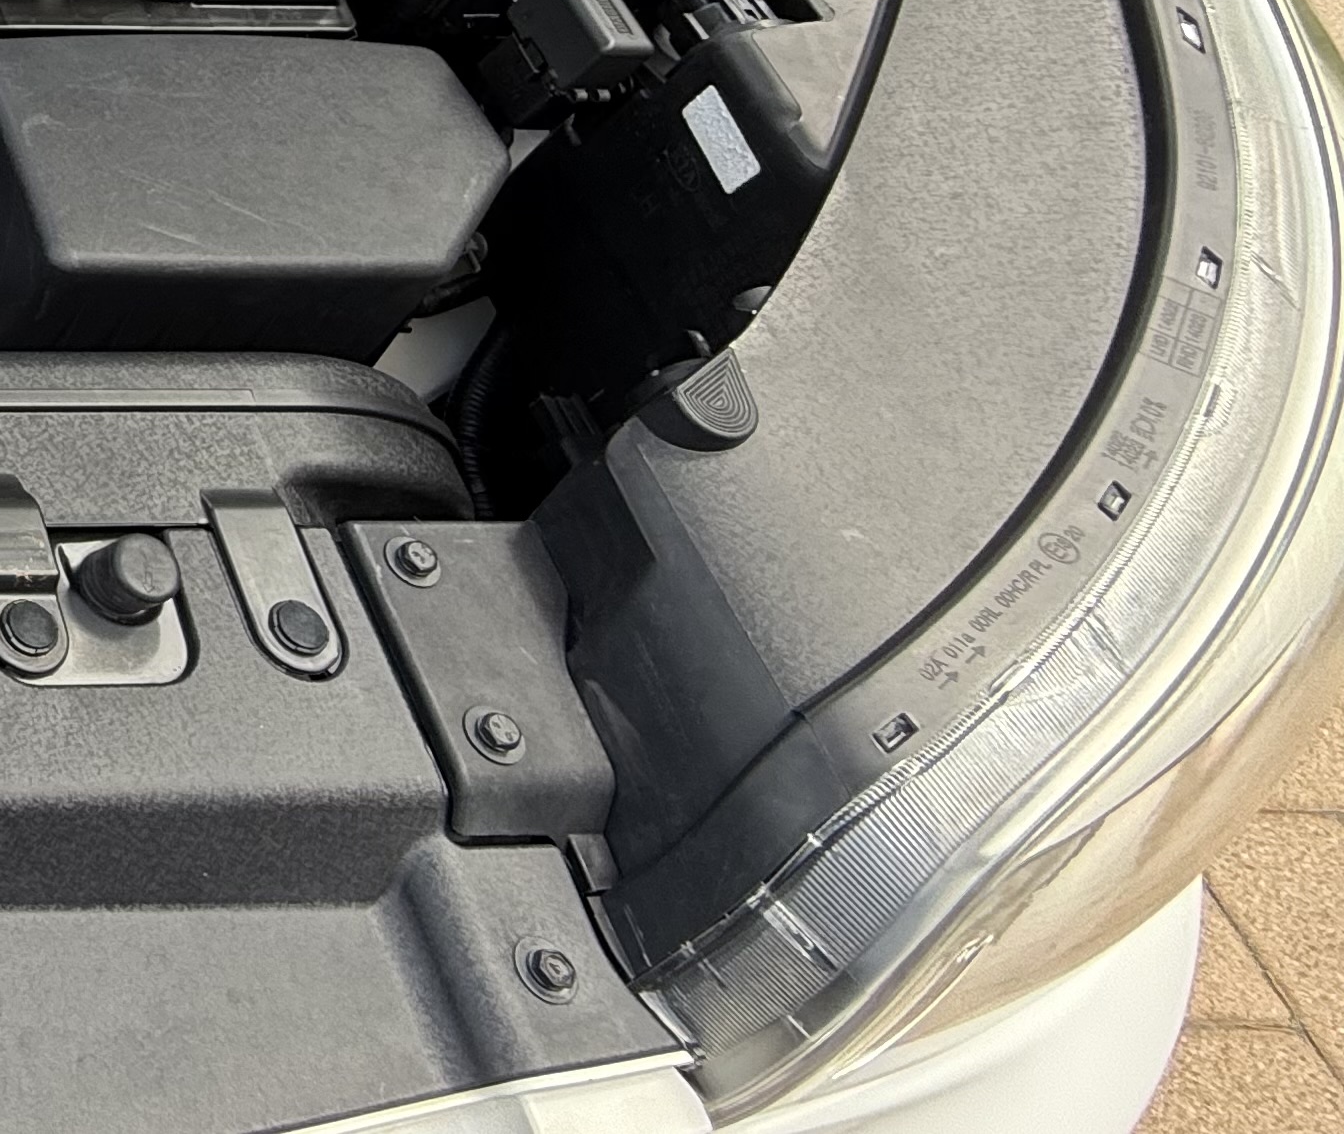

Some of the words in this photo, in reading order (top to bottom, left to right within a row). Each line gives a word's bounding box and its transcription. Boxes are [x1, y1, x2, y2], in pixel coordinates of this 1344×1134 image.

[1149, 333, 1168, 358] LHD
[1176, 344, 1198, 370] RHD
[1028, 559, 1053, 576] PL
[1063, 525, 1086, 542] 20
